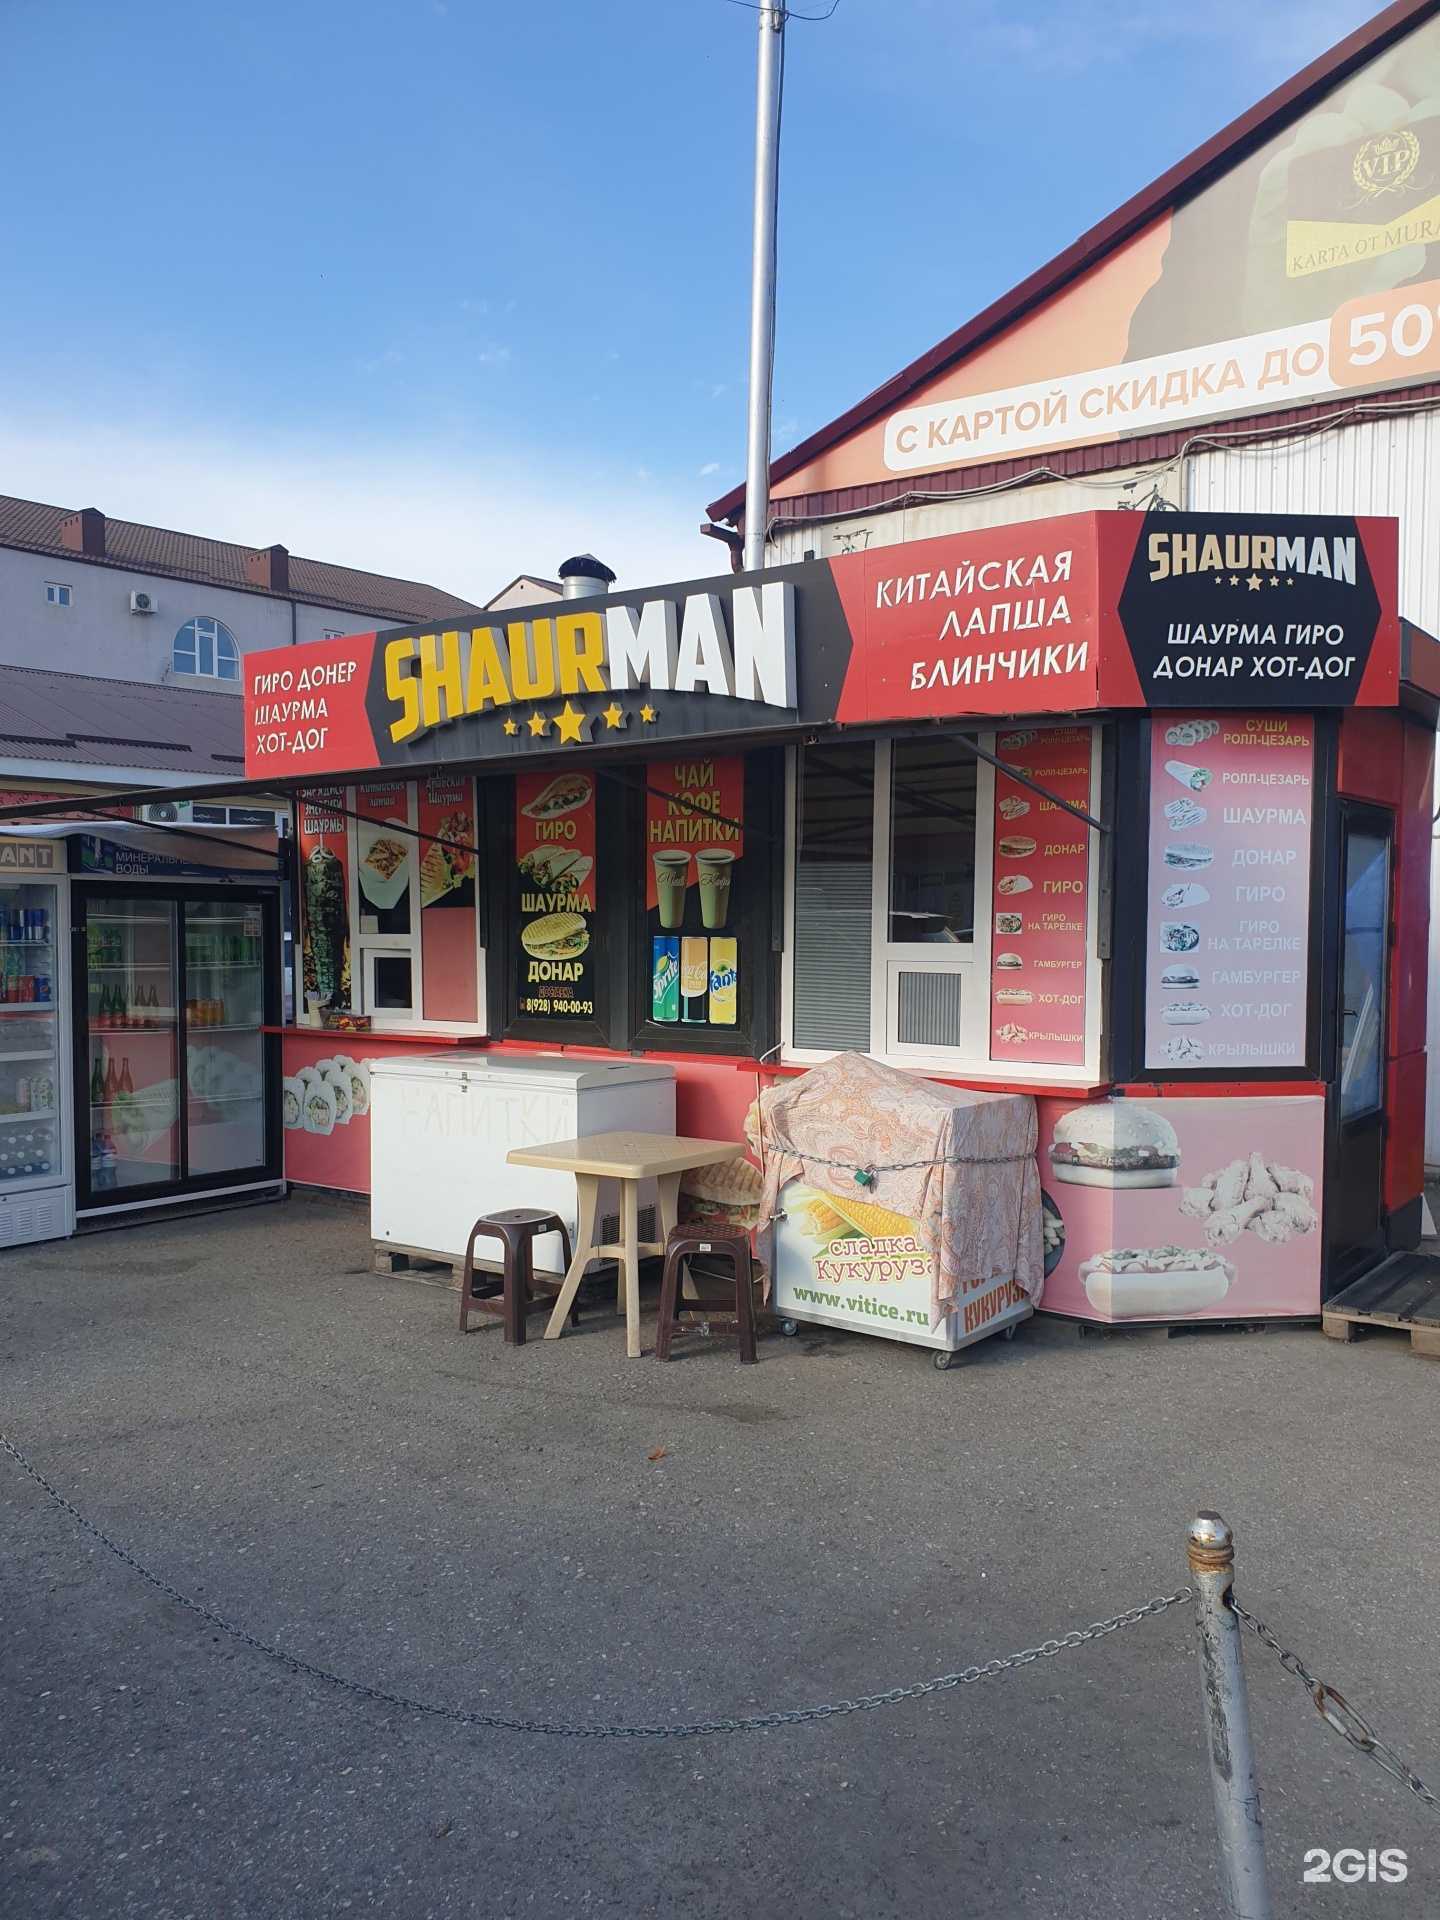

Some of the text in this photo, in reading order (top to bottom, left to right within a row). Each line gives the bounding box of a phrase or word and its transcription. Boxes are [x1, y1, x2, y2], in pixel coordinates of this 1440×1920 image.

[1363, 150, 1410, 179] VIP
[1292, 245, 1350, 273] KARTA
[1355, 234, 1380, 255] OT
[896, 302, 1440, 455] С КАРТОЙ СКИДКА ДО 50
[1149, 533, 1356, 586] SHAURMAN
[876, 550, 1073, 608] КИТАЙСКАЯ
[939, 595, 1072, 640] ЛАПША
[1167, 623, 1344, 645] ШАУРМА ГИРО
[384, 582, 797, 744] SHAURMAN
[911, 641, 1089, 690] БЛИНЧИКИ
[1153, 655, 1356, 679] ДОНАР ХОТ-ДОГ
[254, 661, 357, 695] ГИРО ДОНЕР
[255, 697, 328, 726] ШАУРМА
[1246, 719, 1288, 733] СУШИ
[256, 727, 328, 755] ХОТ-ДОГ
[1223, 733, 1310, 747] РОЛЛ-ЦЕЗАРЬ
[674, 757, 715, 789] ЧАЙ
[1222, 772, 1310, 786] РОЛЛ-ЦЕЗАРЬ
[667, 790, 721, 816] КОФЕ
[304, 816, 345, 834] ШАУРМЫ
[1224, 808, 1307, 825] ШАУРМА
[535, 819, 577, 841] ГИРО
[650, 817, 740, 843] НАПИТКИ
[1044, 844, 1086, 857] ДОНАР
[1232, 850, 1297, 867] ДОНАР
[116, 863, 149, 875] ВОДЫ
[1043, 880, 1083, 894] ГИРО
[1236, 886, 1286, 902] ГИРО
[521, 893, 592, 913] ШАУРМА
[1028, 922, 1083, 932] НА ТАРЕЛКЕ
[1042, 913, 1066, 923] ГИРО
[1239, 920, 1280, 934] ГИРО
[1208, 937, 1301, 951] НА ТАРЕЛКЕ
[527, 961, 584, 983] ДОНАР
[1034, 960, 1082, 970] ГАМБУРГЕР
[1212, 970, 1301, 984] ГАМБУРГЕР
[553, 1000, 593, 1014] 940-00-93
[1039, 994, 1084, 1006] ХОТ-ДОГ
[1220, 1003, 1292, 1019] ХОТ-ДОГ
[1029, 1032, 1084, 1043] КРЫЛЫШКИ
[1209, 1042, 1296, 1057] КРЫЛЫШКИ
[793, 1287, 929, 1326] www.vitice.ru
